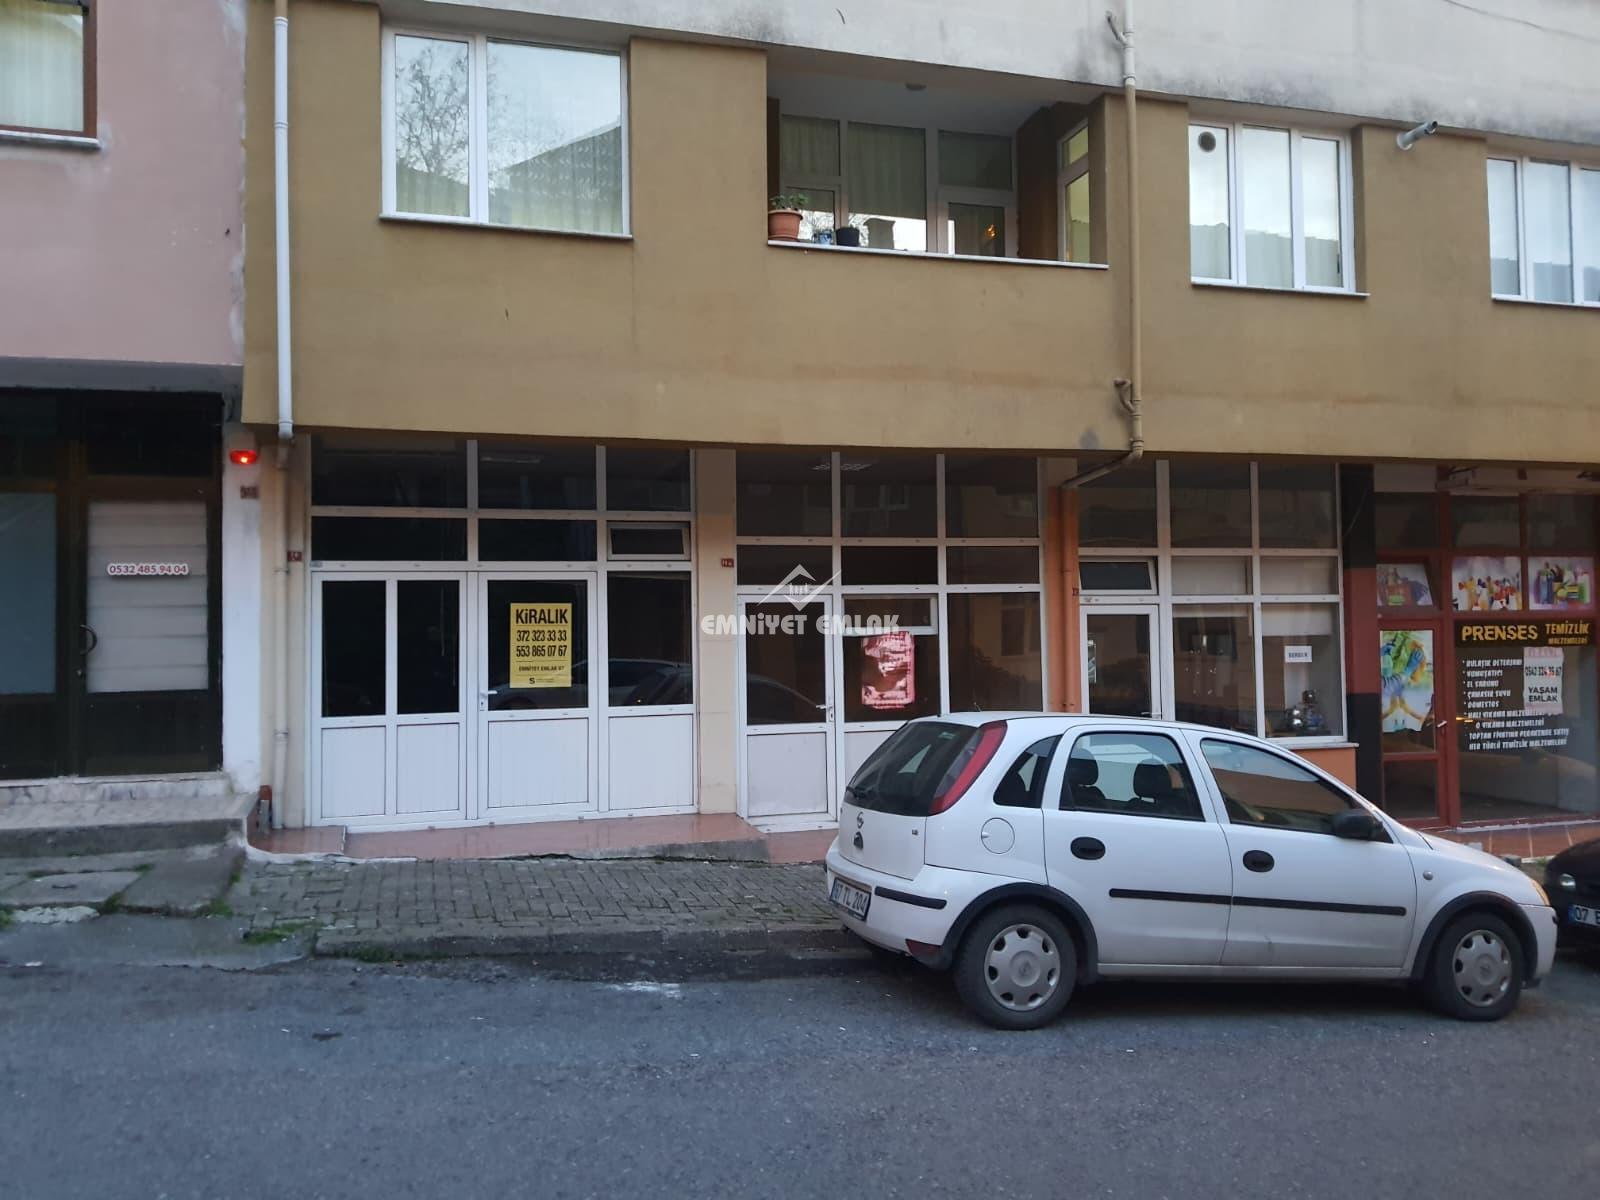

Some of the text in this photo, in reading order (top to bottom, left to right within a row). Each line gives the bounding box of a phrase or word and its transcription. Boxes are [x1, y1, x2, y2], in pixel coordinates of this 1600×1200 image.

[109, 564, 187, 574] 0532 485 94 04
[515, 608, 568, 624] KiRALIK
[516, 630, 567, 642] 372 323 33 33
[1461, 620, 1590, 641] PRENSES TEMİZLİK
[516, 645, 567, 657] 553 865 07 67
[1528, 695, 1558, 703] EMLAK
[1575, 907, 1588, 921] 07
